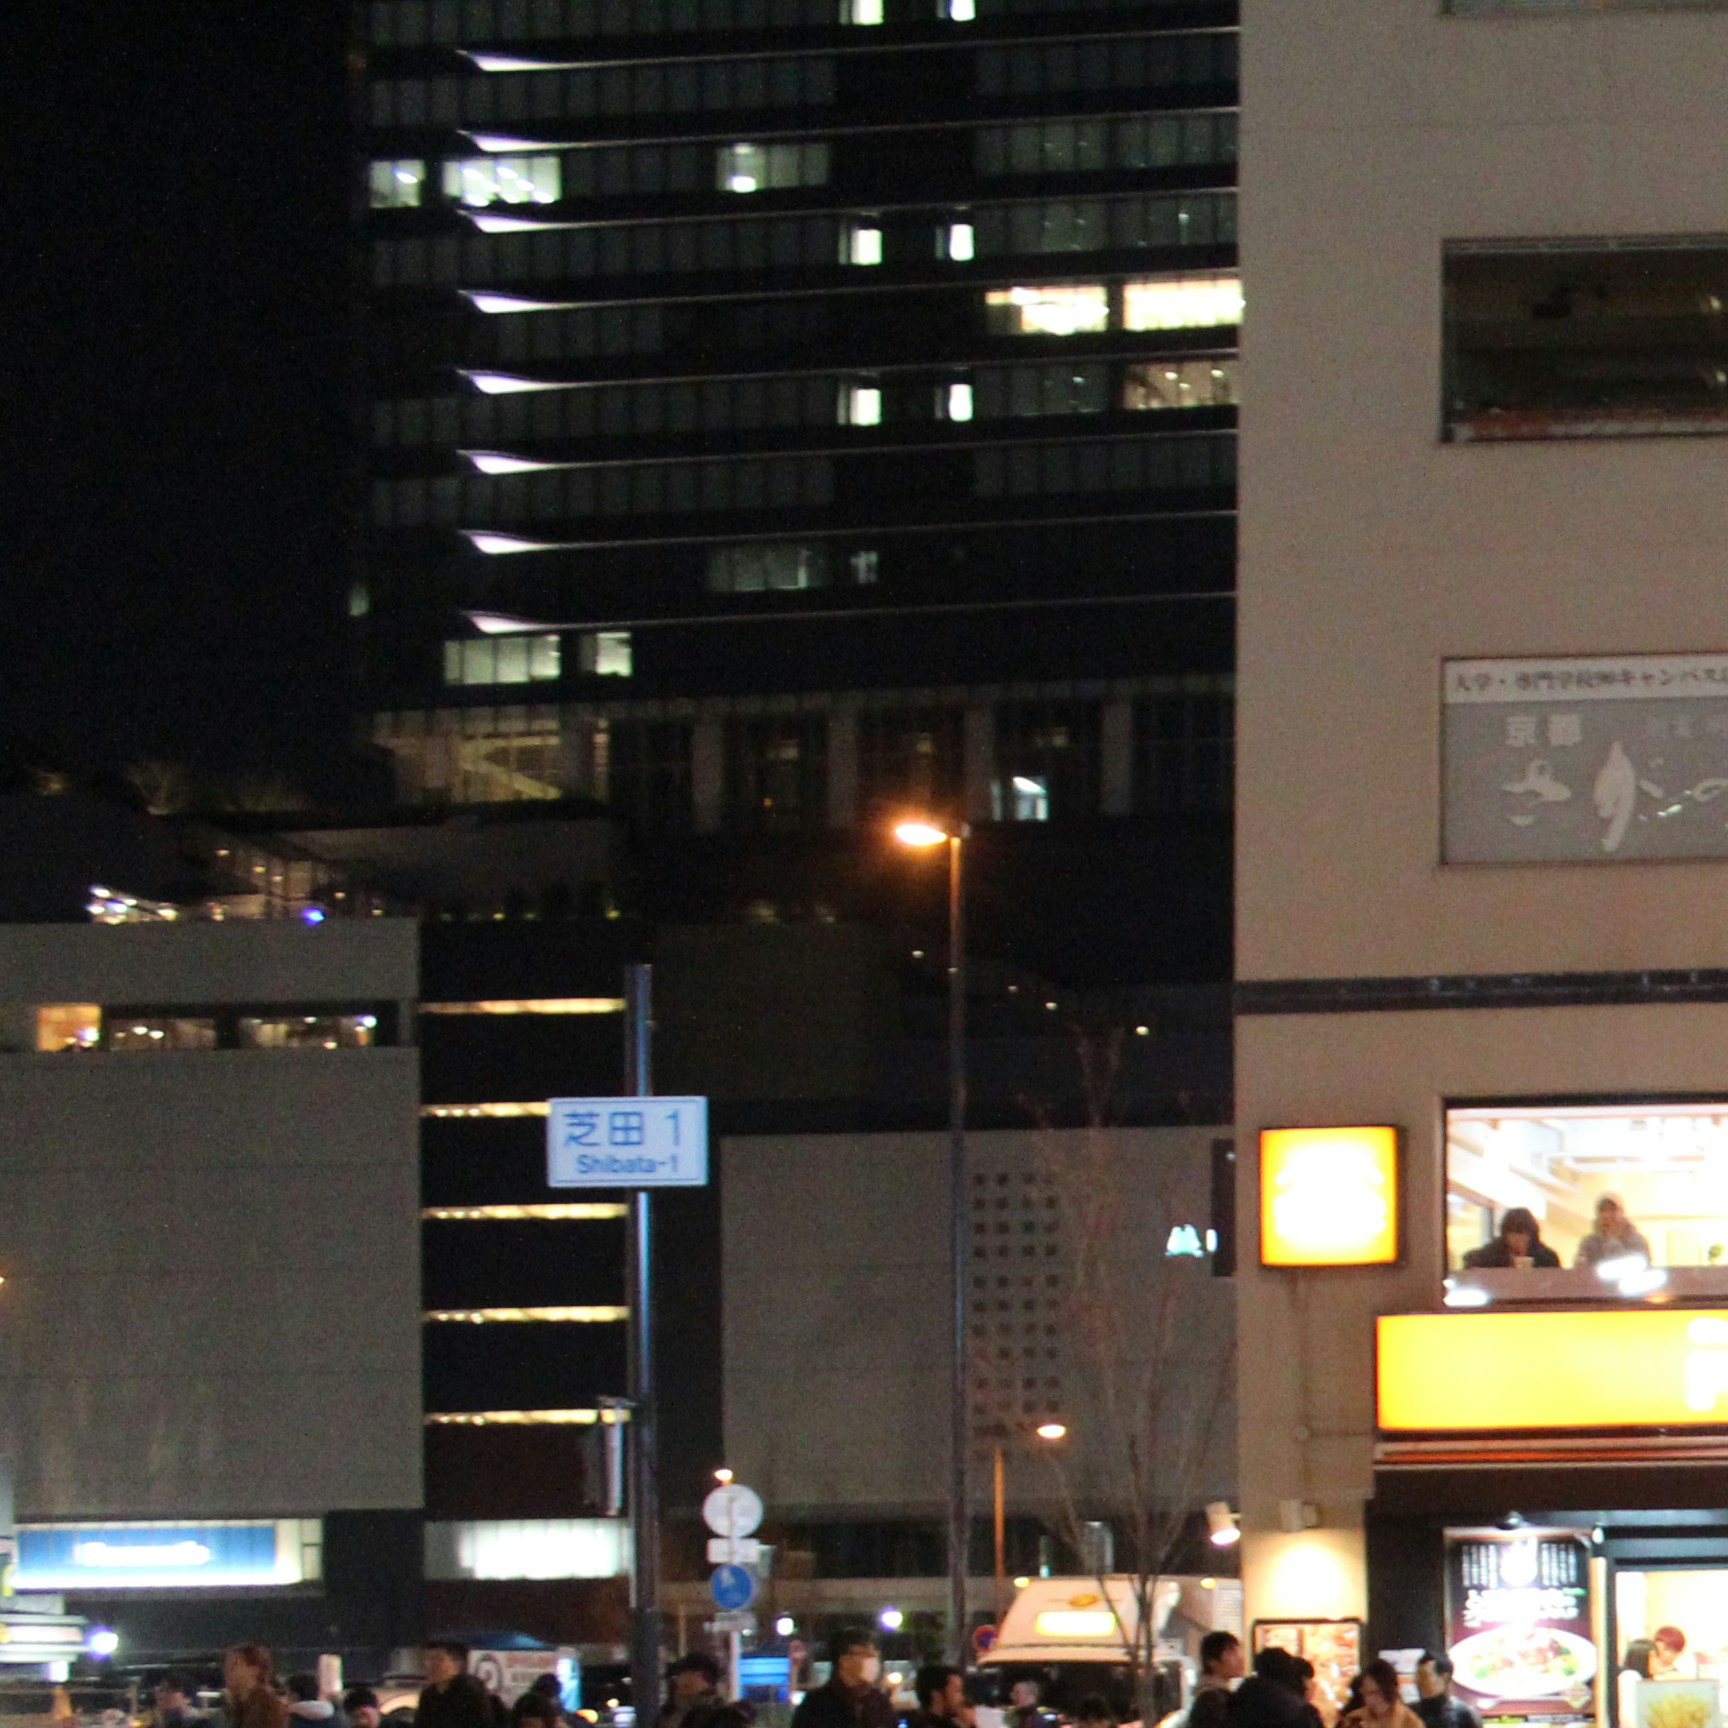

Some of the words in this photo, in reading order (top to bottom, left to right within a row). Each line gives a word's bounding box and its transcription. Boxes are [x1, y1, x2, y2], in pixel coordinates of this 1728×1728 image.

[563, 1109, 642, 1146] 芝田
[665, 1109, 681, 1146] 1
[577, 1153, 678, 1174] Shibata-1
